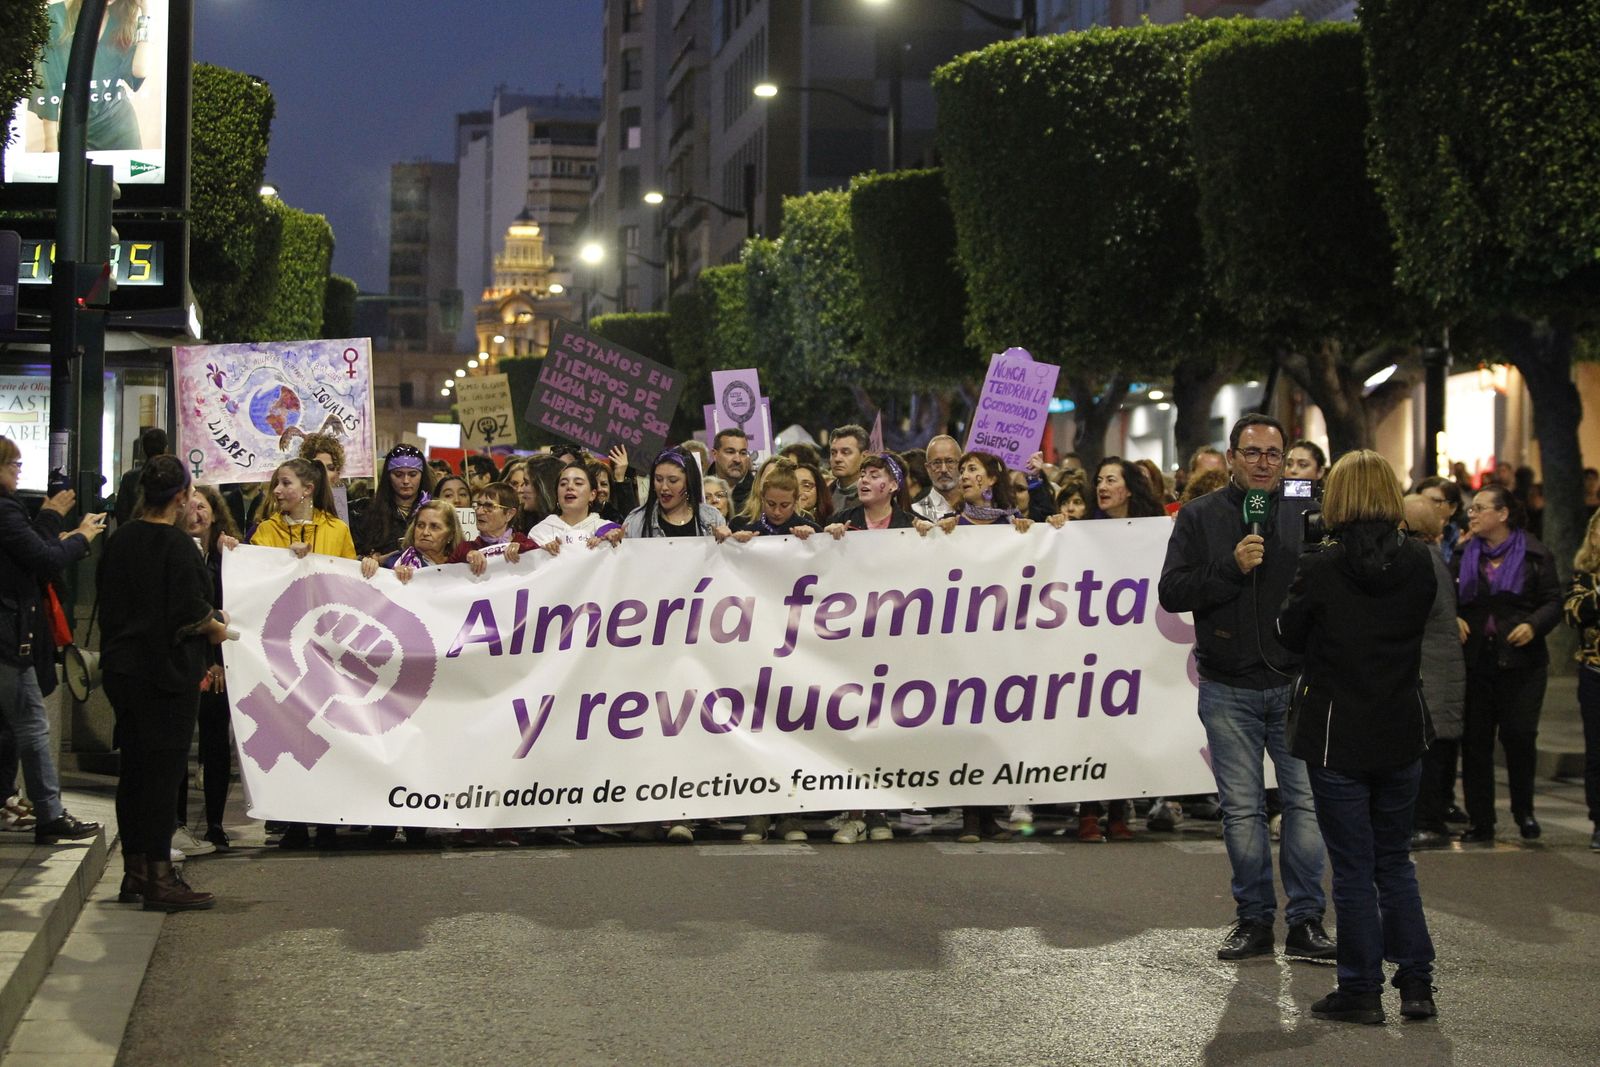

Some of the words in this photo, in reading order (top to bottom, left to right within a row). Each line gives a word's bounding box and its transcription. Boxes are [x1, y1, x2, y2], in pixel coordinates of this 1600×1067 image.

[62, 79, 126, 91] EVA
[554, 350, 629, 397] TIEMPOS
[634, 387, 661, 411] DE
[562, 333, 642, 377] ESTAMOS
[647, 369, 673, 392] EN
[993, 360, 1027, 383] NUNCA
[312, 386, 361, 431] IGUALES
[539, 366, 586, 400] LUCHA
[588, 389, 605, 407] SI
[608, 396, 640, 422] POR
[642, 412, 670, 438] SER
[540, 390, 596, 424] LIBRES
[606, 419, 644, 445] NOS
[1033, 389, 1048, 407] LA
[207, 418, 256, 468] LIBRES
[540, 411, 603, 448] LLAMAN
[977, 414, 991, 429] de
[994, 420, 1035, 439] nuestro
[445, 576, 756, 658] Almería
[773, 565, 1150, 657] feminista
[511, 693, 556, 760] y
[575, 653, 1142, 740] revolucionaria
[388, 782, 583, 810] Coordinadora
[592, 779, 627, 803] de
[635, 772, 782, 801] colectivos
[787, 765, 940, 797] feministas
[948, 762, 985, 786] de
[992, 756, 1108, 786] Almería
